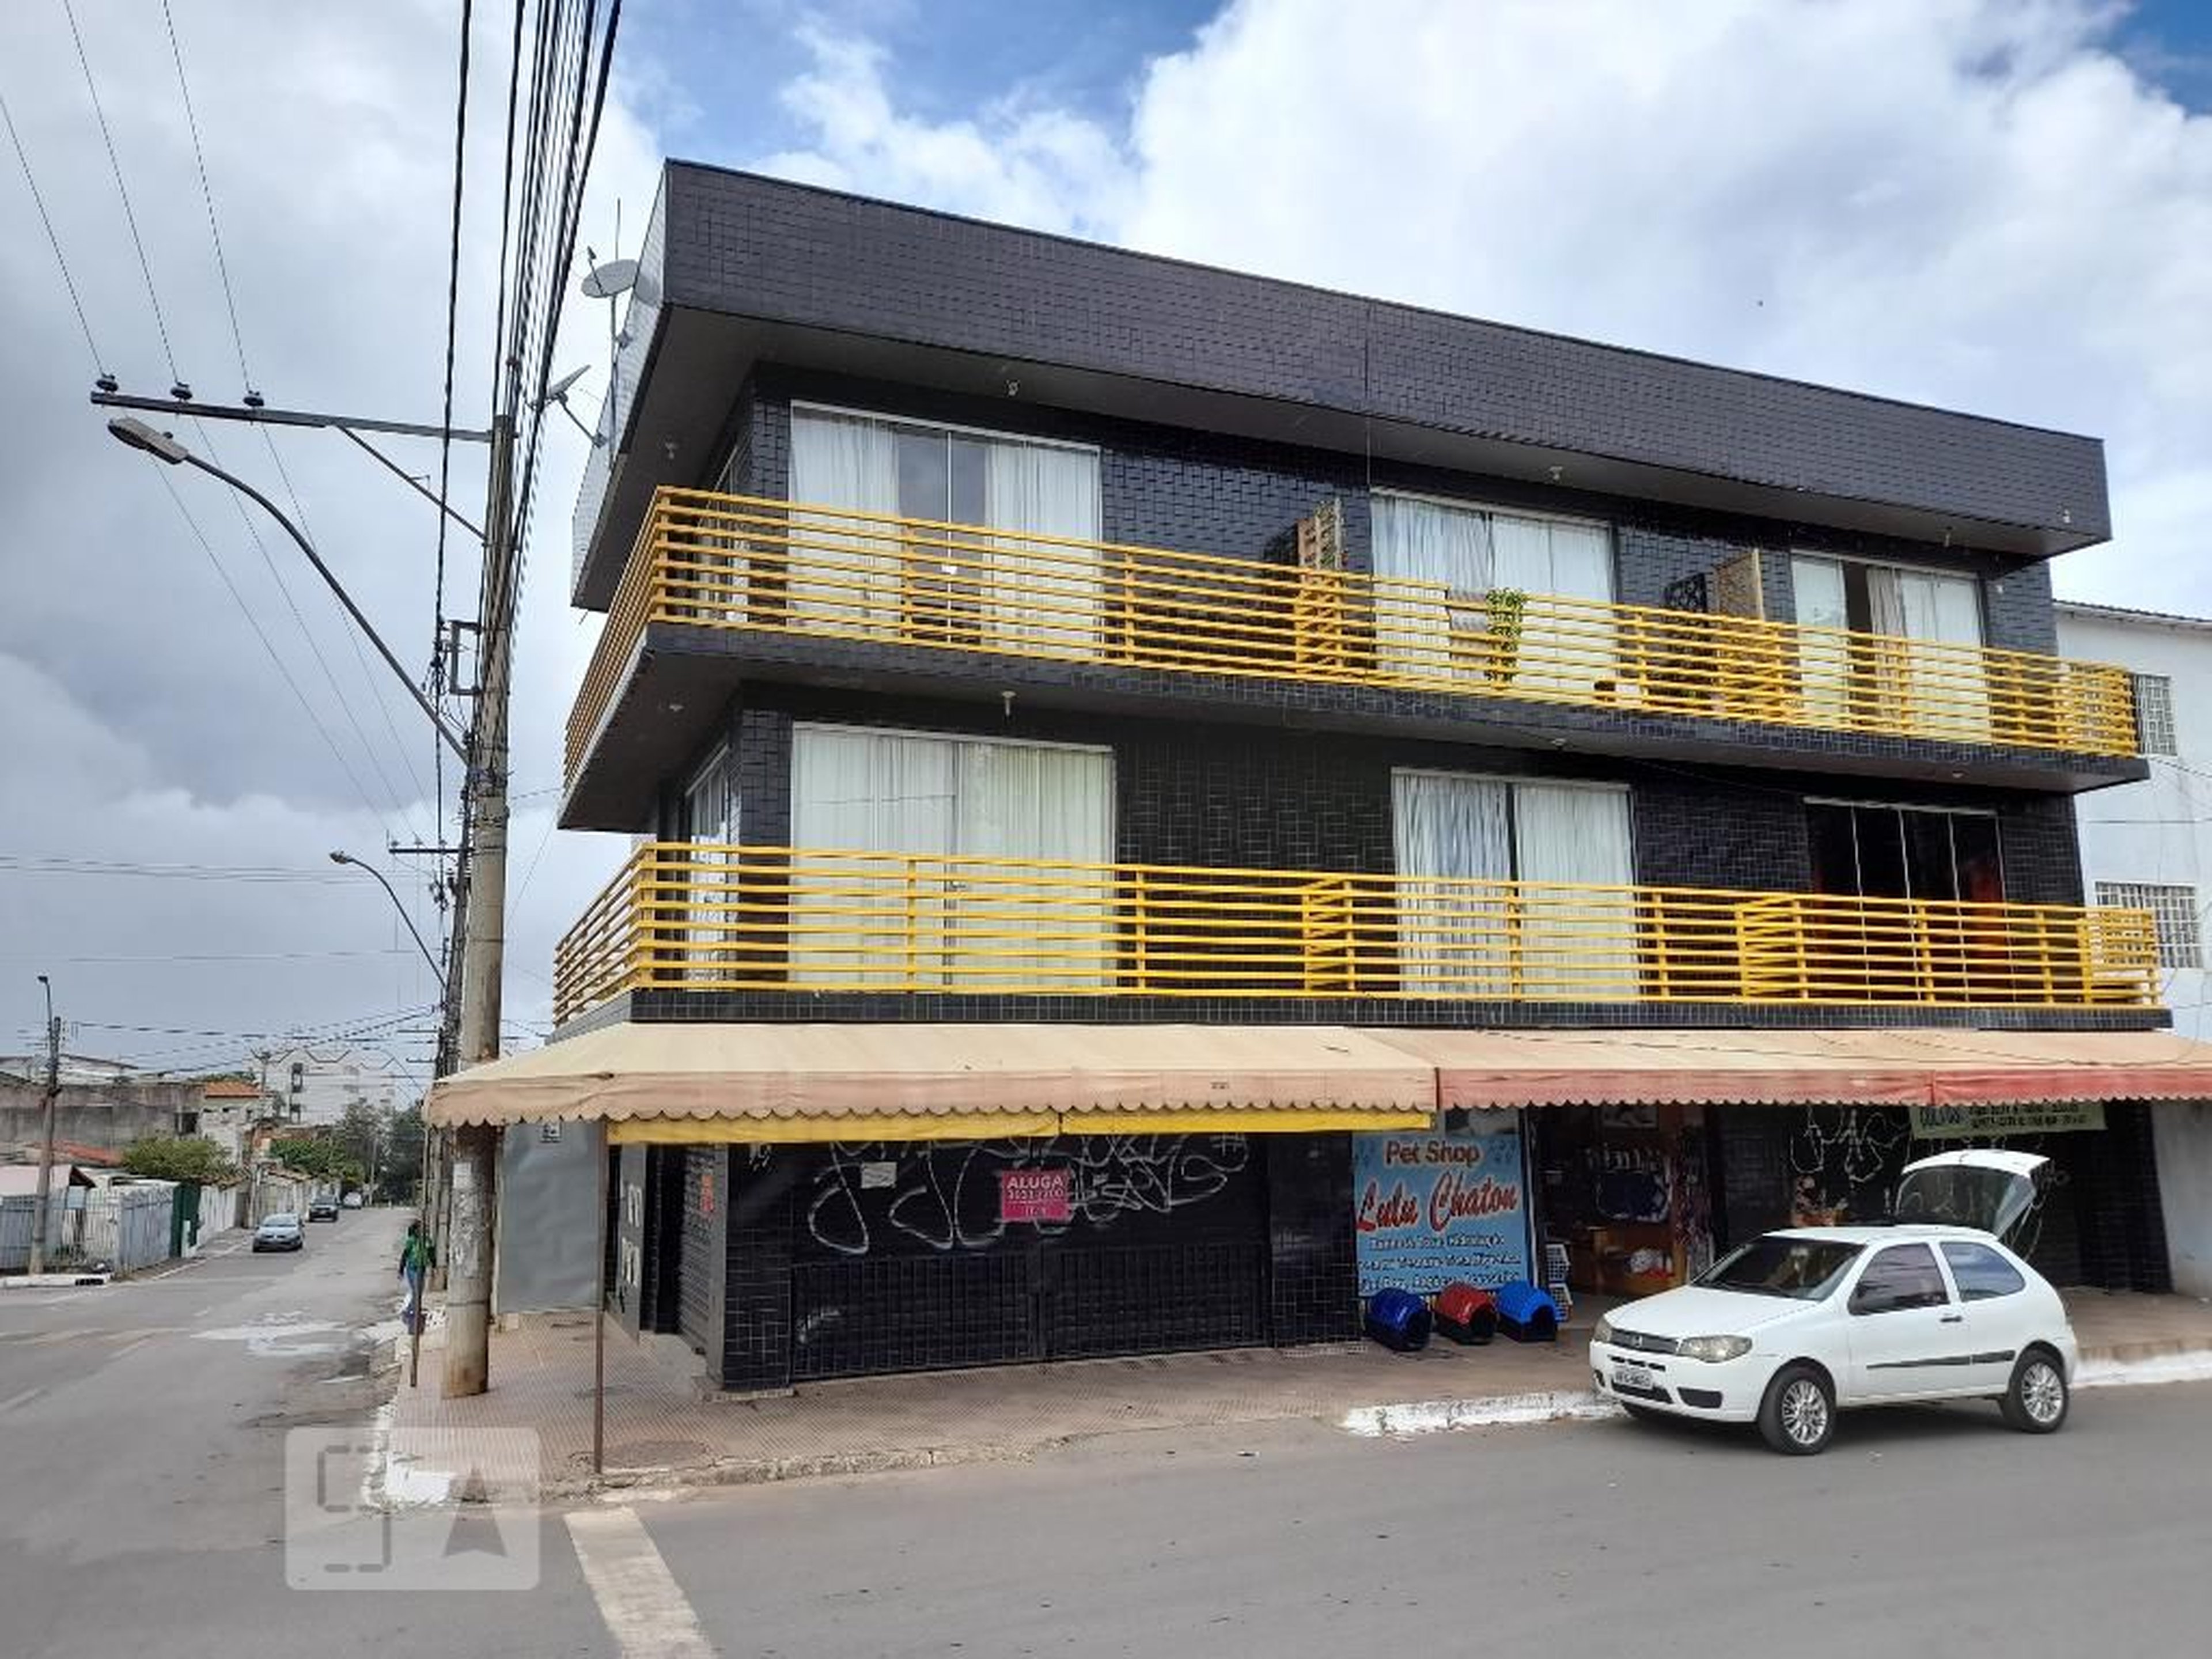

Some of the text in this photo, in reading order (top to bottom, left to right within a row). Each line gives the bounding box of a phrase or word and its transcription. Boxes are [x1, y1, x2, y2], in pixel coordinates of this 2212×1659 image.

[1385, 1140, 1481, 1167] Pet Shop
[1007, 1176, 1063, 1189] ALUGA
[1355, 1181, 1419, 1232] Lulu
